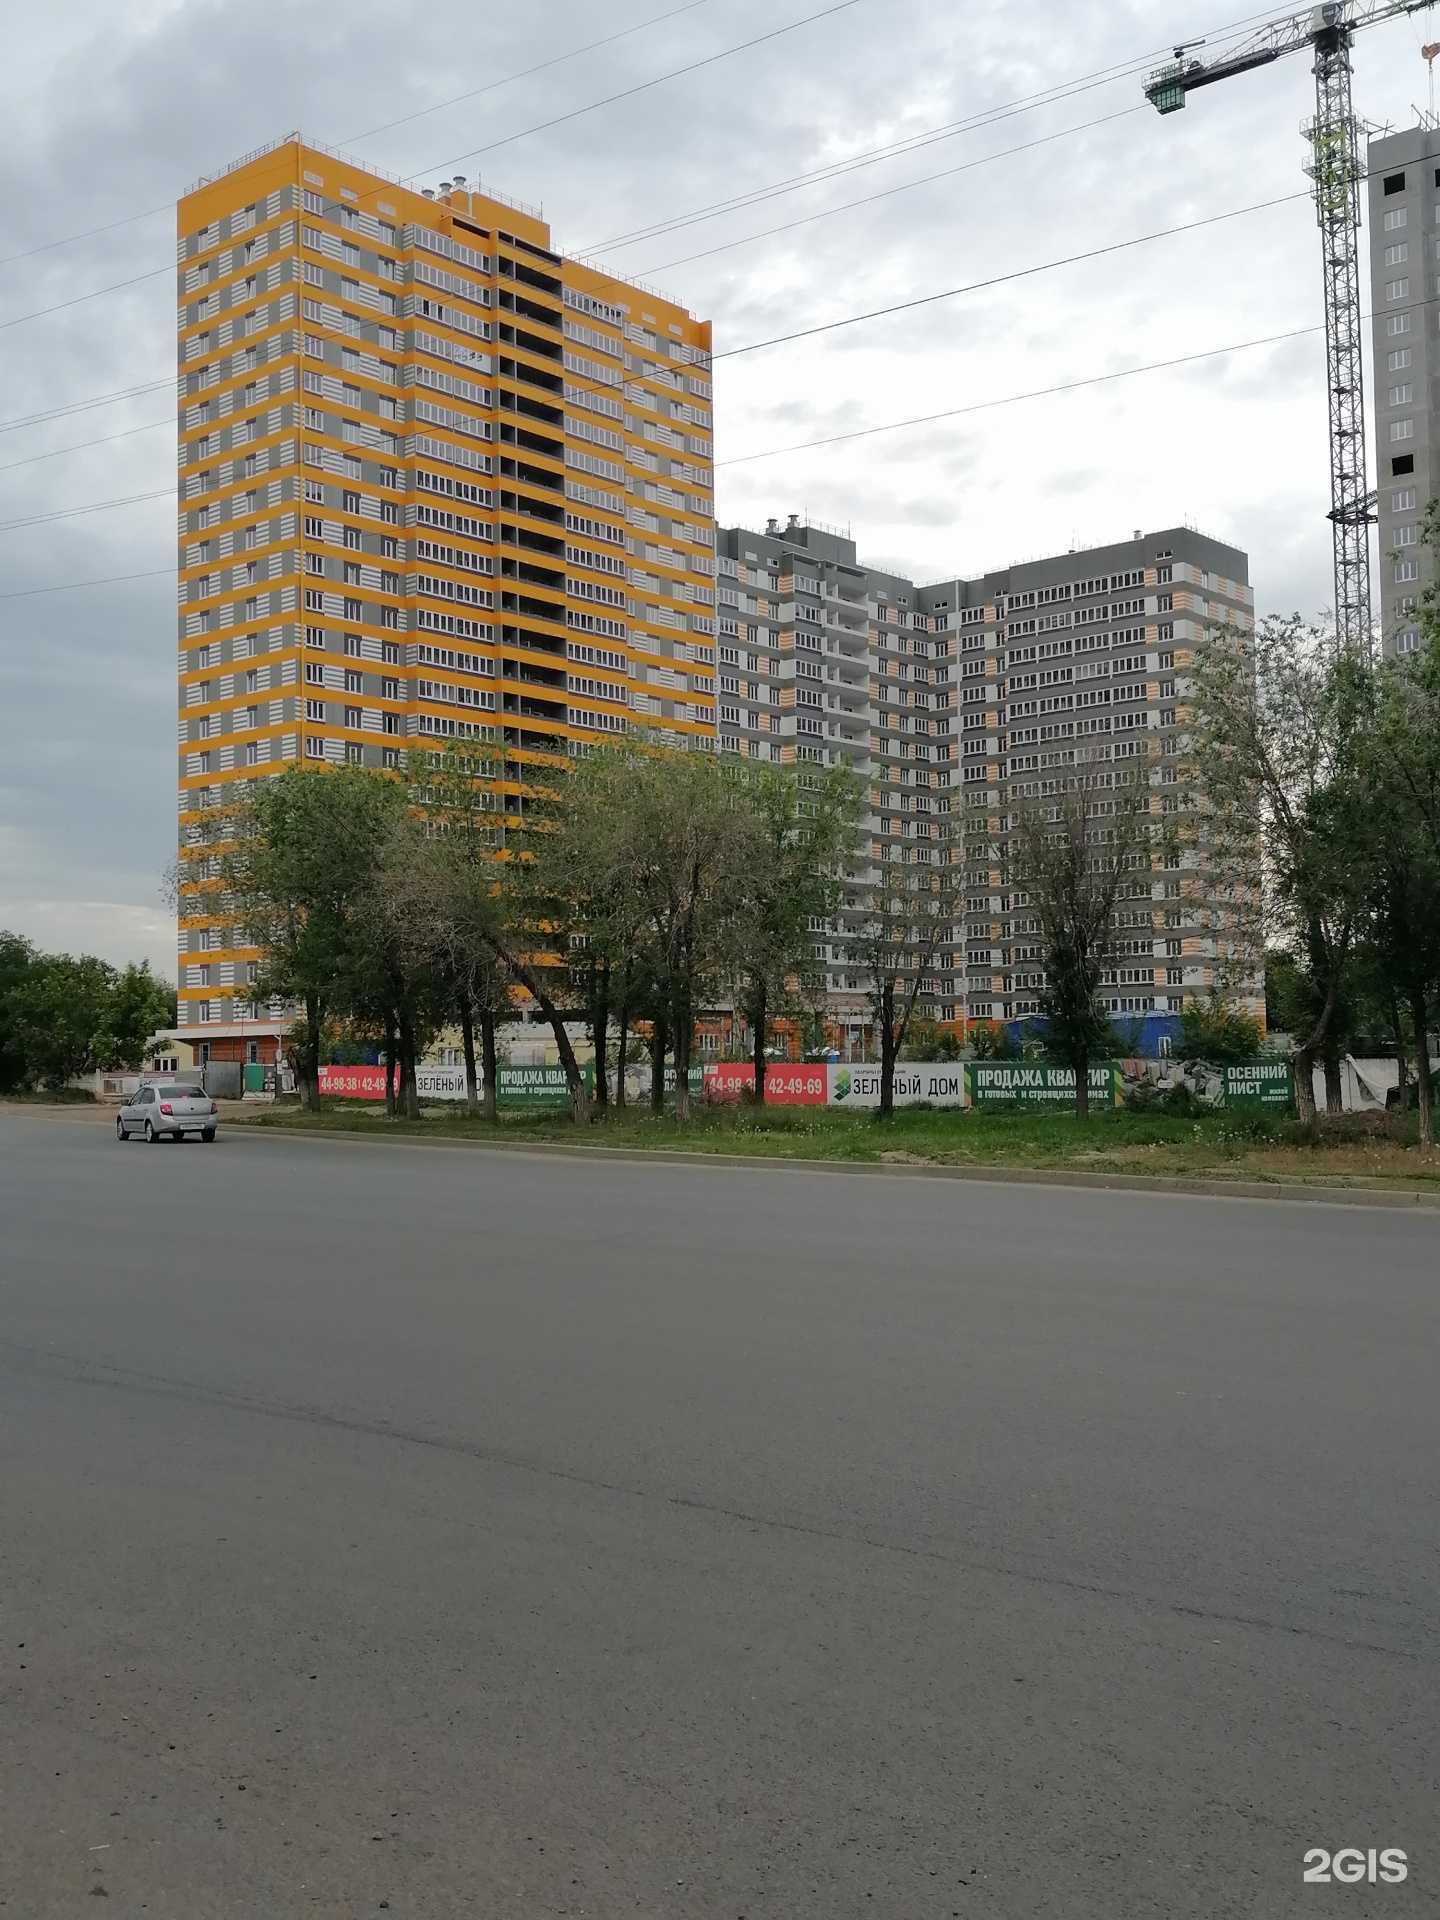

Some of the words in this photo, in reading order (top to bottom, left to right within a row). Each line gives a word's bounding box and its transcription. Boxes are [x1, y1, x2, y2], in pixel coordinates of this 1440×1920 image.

[500, 1071, 544, 1086] ПРОДАЖА
[545, 1071, 587, 1085] КВАРР
[977, 1069, 1044, 1089] ПРОДАЖА
[1047, 1069, 1110, 1087] КВАИР
[1227, 1062, 1288, 1080] ОСЕННИЙ
[362, 1077, 398, 1091] 42-499
[768, 1077, 823, 1094] 42-49-69
[853, 1074, 921, 1095] ЗЕЛНЫЙ
[928, 1078, 959, 1097] ДОМ
[1228, 1081, 1262, 1095] ЛИСТ
